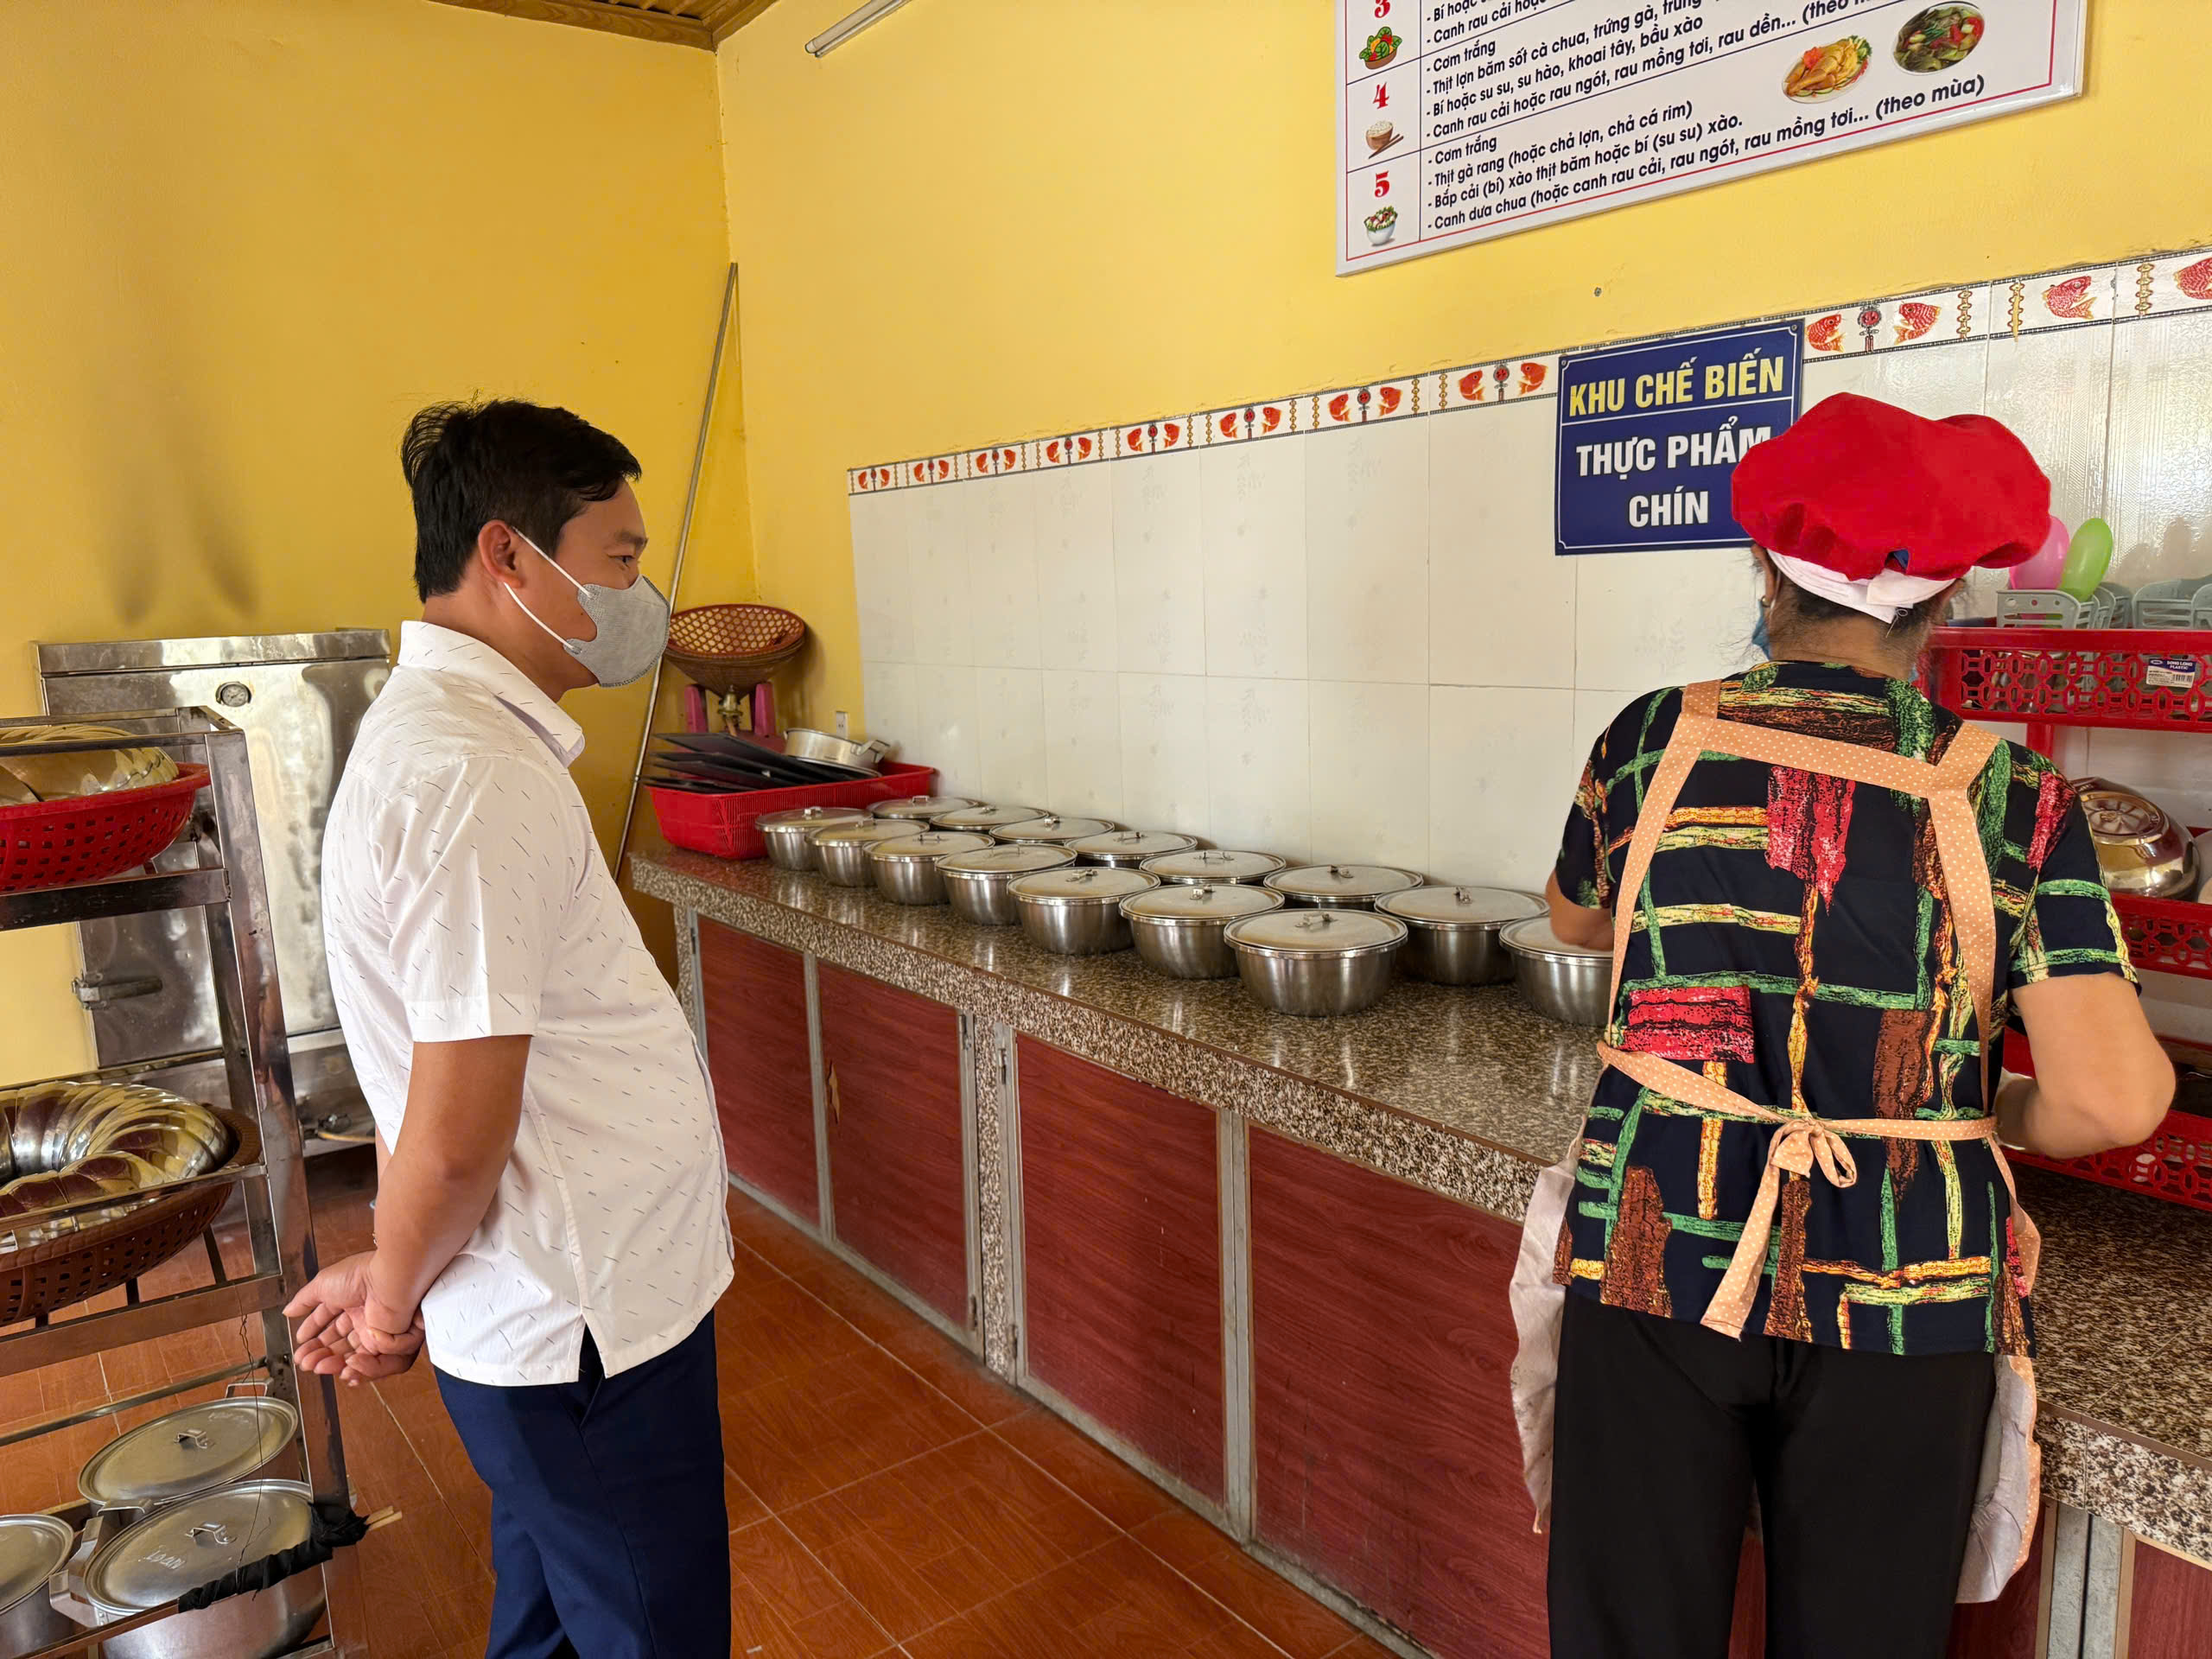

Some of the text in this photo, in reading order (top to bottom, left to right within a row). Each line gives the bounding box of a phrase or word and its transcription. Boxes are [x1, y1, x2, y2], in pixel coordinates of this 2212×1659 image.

[1375, 0, 1390, 18] 3
[1433, 22, 1465, 43] Canh
[1468, 14, 1488, 31] rau
[1491, 2, 1511, 22] cải
[1434, 3, 1445, 22] Bí
[1433, 76, 1452, 94] Thịt
[1456, 72, 1474, 89] lợn
[1478, 60, 1505, 79] băm
[1509, 47, 1528, 68] sốt
[1531, 41, 1548, 60] cà
[1552, 32, 1589, 53] chua,
[1593, 16, 1630, 39] trứng
[1634, 4, 1658, 31] gà,
[1433, 54, 1460, 72] Cơm
[1464, 39, 1496, 61] trắng
[1433, 99, 1444, 117] Bí
[1447, 92, 1477, 112] hoặc
[1480, 87, 1493, 101] su
[1497, 81, 1514, 95] su,
[1517, 74, 1531, 88] su
[1535, 64, 1564, 83] hào,
[1568, 46, 1606, 72] khoai
[1610, 39, 1635, 57] tây,
[1640, 23, 1669, 48] bầu
[1674, 16, 1703, 37] xào
[1373, 83, 1389, 109] 4
[1433, 118, 1464, 137] Canh
[1468, 112, 1486, 128] rau
[1491, 101, 1510, 120] cải
[1514, 92, 1546, 113] hoặc
[1550, 85, 1571, 101] rau
[1575, 70, 1610, 94] ngót,
[1615, 63, 1637, 80] rau
[1643, 47, 1684, 72] mồng
[1689, 36, 1713, 57] tơi,
[1719, 29, 1745, 48] rau
[1434, 169, 1454, 188] Thịt
[1458, 163, 1473, 184] gà
[1477, 157, 1504, 175] rang
[1509, 143, 1546, 169] (hoặc
[1549, 132, 1574, 154] chả
[1580, 130, 1603, 148] lợn,
[1608, 114, 1635, 137] chả
[1639, 108, 1658, 128] cá
[1662, 100, 1692, 122] rim)
[1434, 211, 1465, 229] Canh
[1469, 205, 1491, 220] dưa
[1496, 196, 1526, 213] chua
[1530, 184, 1569, 208] (hoặc
[1573, 173, 1607, 194] canh
[1611, 168, 1634, 184] rau
[1638, 157, 1665, 177] cải,
[1670, 152, 1694, 169] rau
[1700, 138, 1738, 163] ngót,
[1745, 132, 1771, 150] rau
[1777, 116, 1825, 142] mồng
[1831, 107, 1869, 128] tơi...
[1876, 92, 1925, 121] (theo
[1932, 74, 1984, 102] mùa)
[1435, 148, 1462, 164] Cơm
[1465, 135, 1497, 156] trắng
[1435, 188, 1457, 208] Bắp
[1460, 183, 1478, 200] cải
[1483, 176, 1504, 199] (bí)
[1509, 171, 1532, 188] xào
[1536, 162, 1556, 181] thịt
[1560, 156, 1590, 175] băm
[1595, 143, 1630, 165] hoặc
[1635, 135, 1649, 154] bí
[1653, 132, 1675, 153] (su
[1680, 123, 1702, 142] su)
[1707, 114, 1742, 134] xào.
[1375, 171, 1389, 197] 5
[1569, 346, 1784, 416] KHU CHẾ BIẾN
[1576, 436, 1656, 480] THỰC
[1629, 485, 1709, 528] CHÍN
